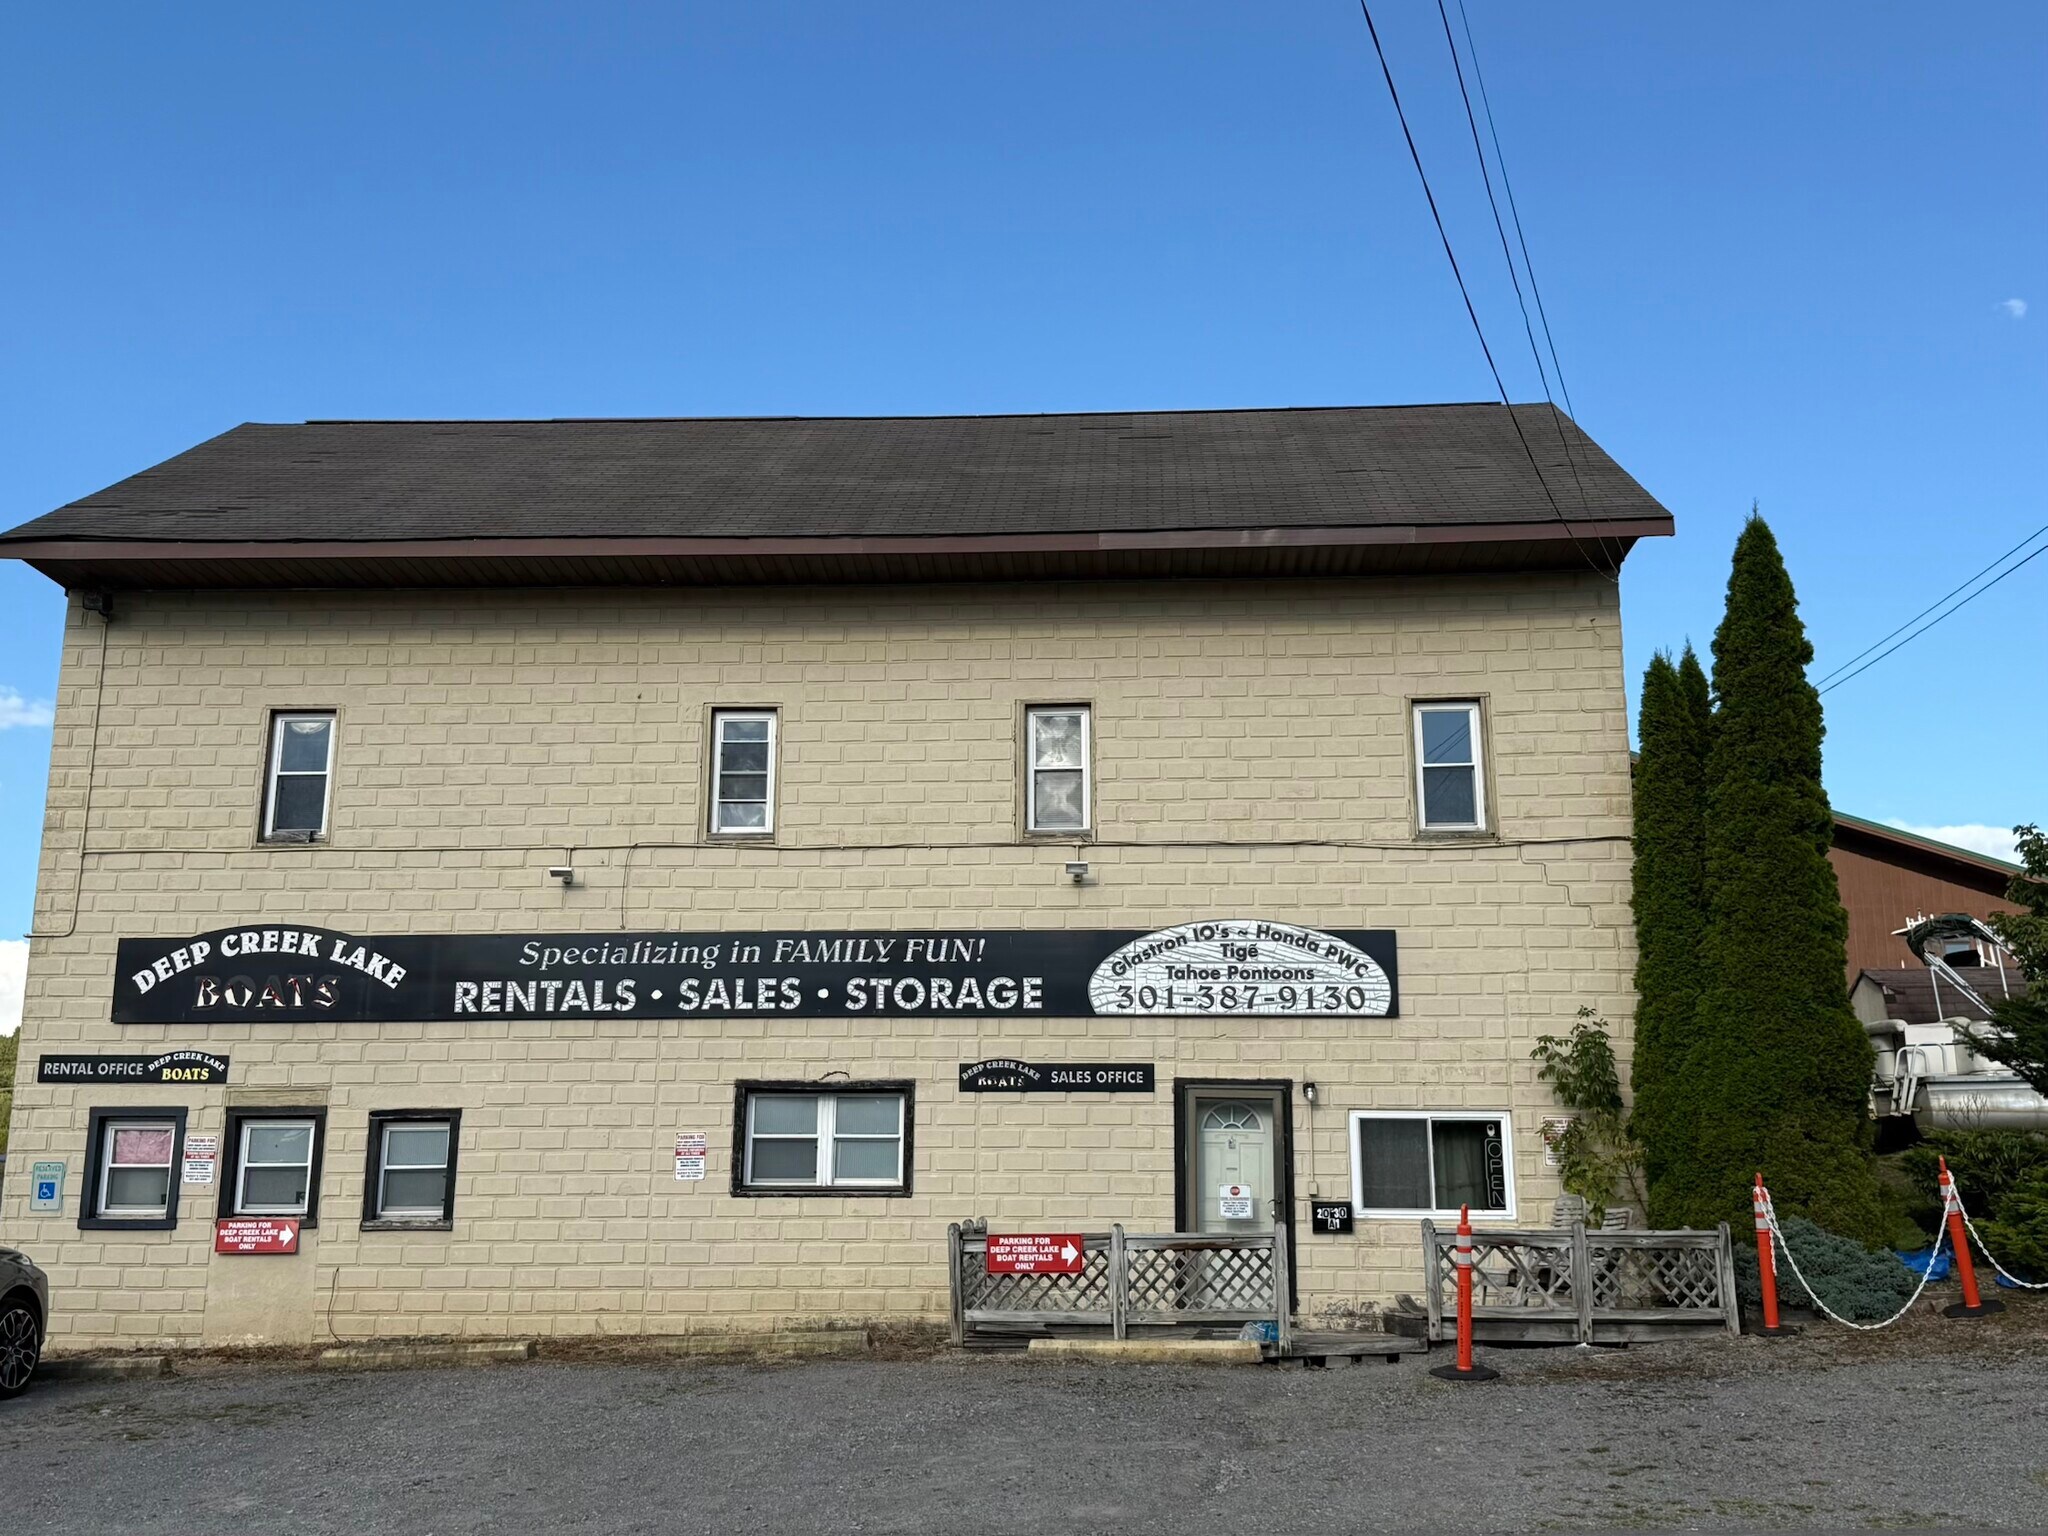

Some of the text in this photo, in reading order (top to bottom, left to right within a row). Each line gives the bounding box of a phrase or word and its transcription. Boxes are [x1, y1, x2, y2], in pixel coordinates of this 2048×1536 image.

[519, 938, 986, 971] Specializing in FAMILY FUN!
[1111, 933, 1188, 977] Glastron
[1256, 924, 1320, 953] Honda
[1324, 945, 1370, 978] PWC
[131, 930, 407, 995] DEEP CREEK LAKE
[1165, 965, 1315, 981] Tahoe Pontoons
[192, 975, 340, 1010] BOATS
[453, 976, 1043, 1013] RENTALS SALES STORAGE
[1116, 984, 1366, 1010] 301-387-9130
[44, 1062, 144, 1075] RENTAL OFFICE
[147, 1052, 226, 1072] DEEP CREEK LAKE
[961, 1060, 1041, 1081] DEEP CREEK LAKE
[161, 1068, 210, 1081] BOATS
[1051, 1071, 1144, 1083] SALES OFFICE
[1488, 1142, 1505, 1204] OPEN
[1328, 1218, 1340, 1229] A1
[999, 1237, 1051, 1245] PARKING FOR
